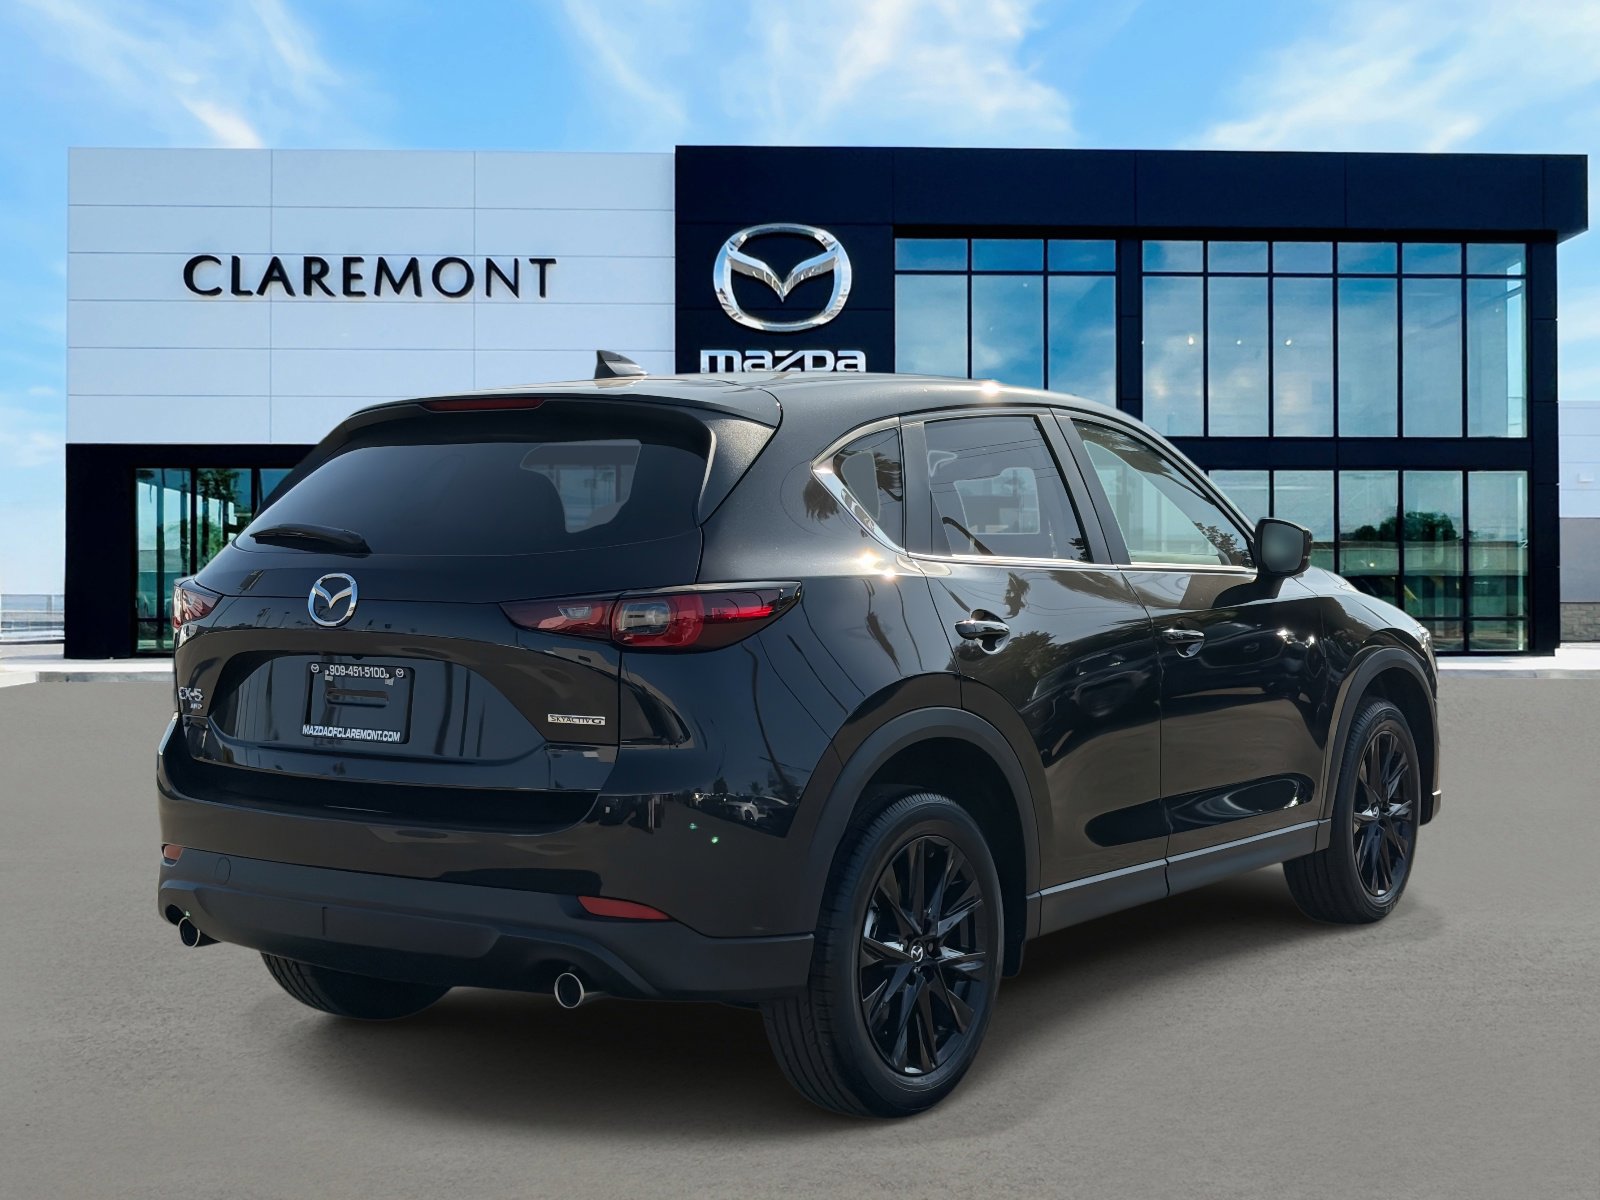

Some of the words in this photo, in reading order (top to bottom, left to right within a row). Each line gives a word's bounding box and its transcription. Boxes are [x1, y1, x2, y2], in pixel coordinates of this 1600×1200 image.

[183, 254, 557, 299] CLAREMONT
[329, 664, 386, 679] 909-451-5100
[178, 686, 204, 702] CX-5
[302, 724, 401, 742] MAZDAOFCLAREMONT.COM
